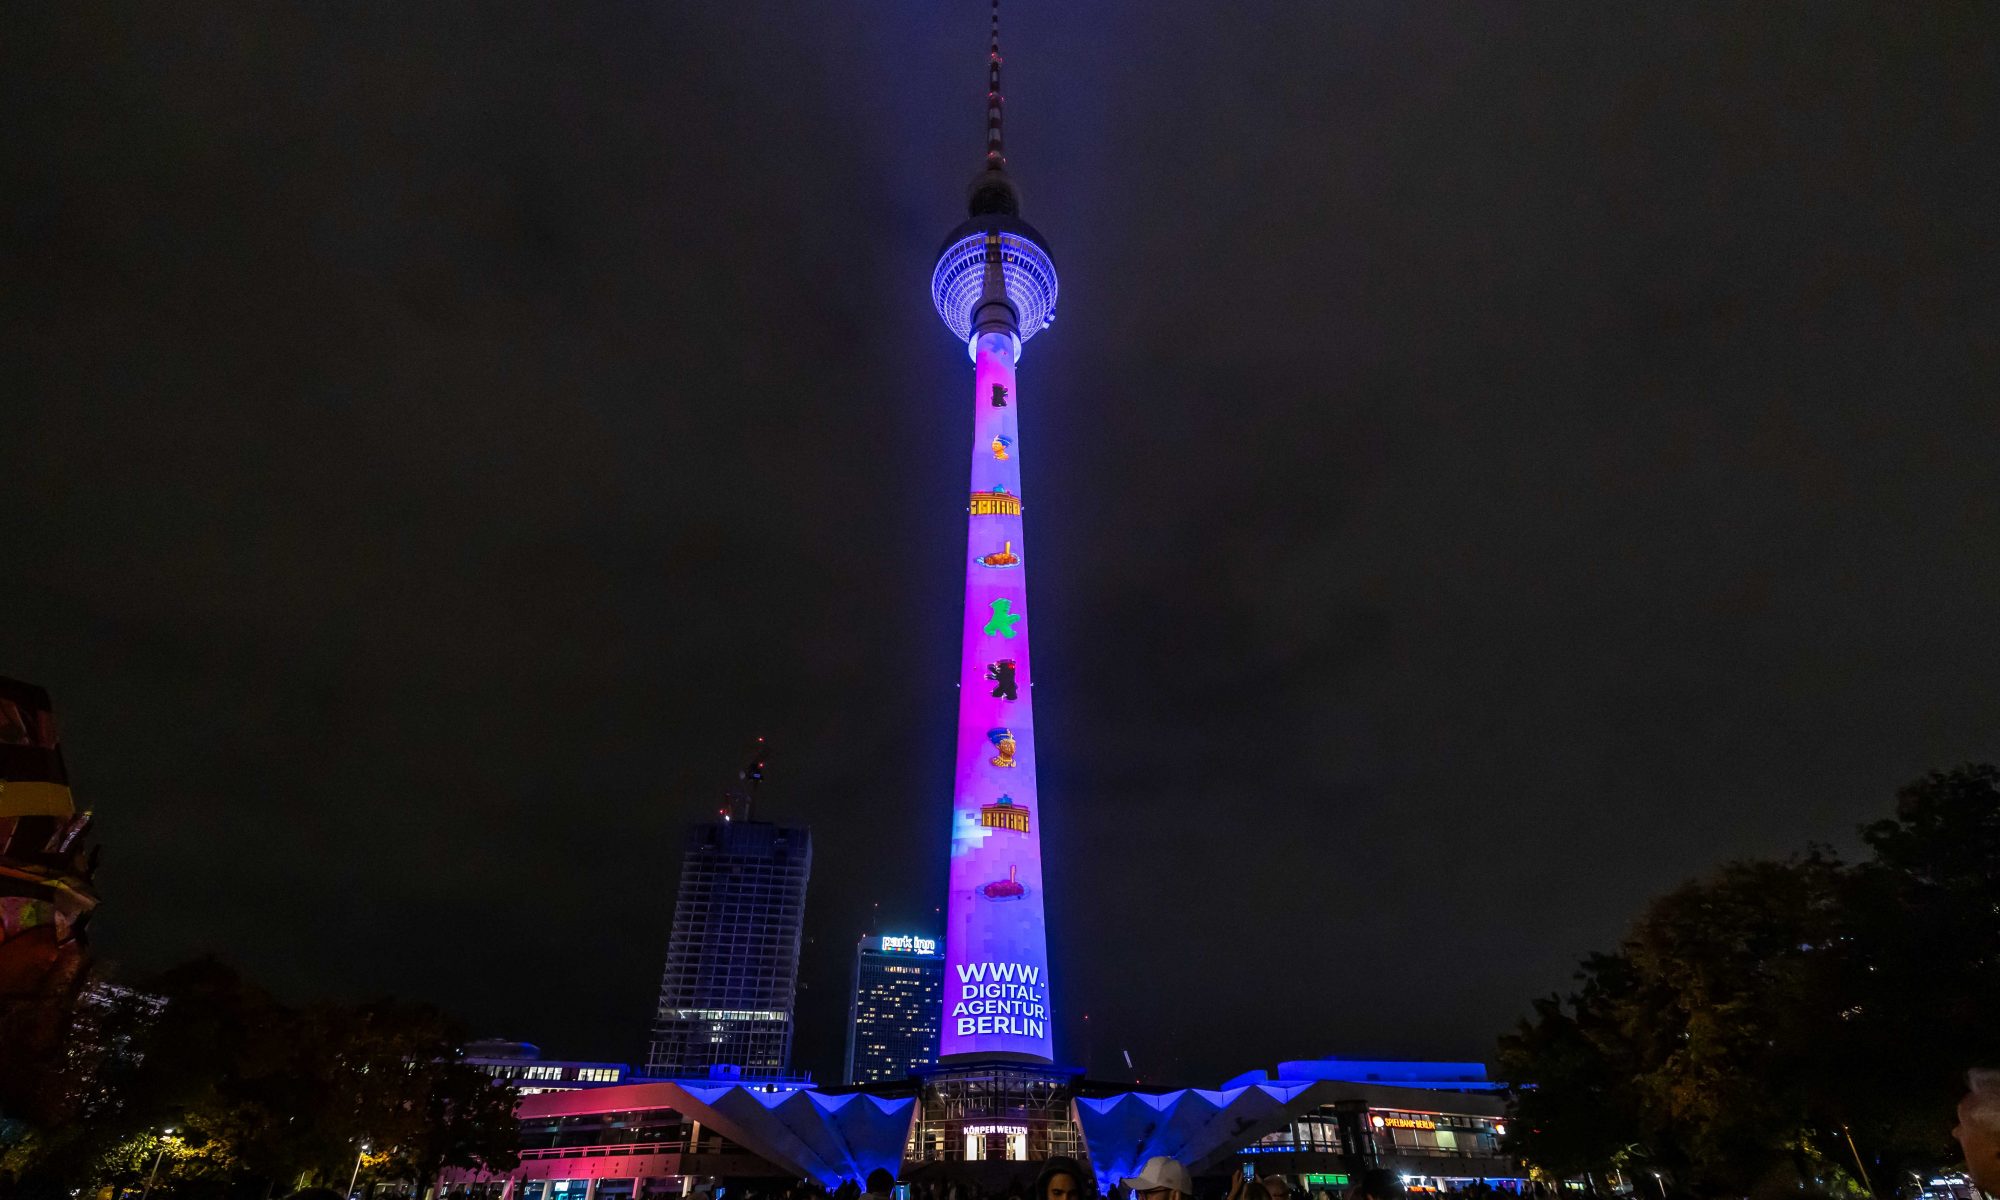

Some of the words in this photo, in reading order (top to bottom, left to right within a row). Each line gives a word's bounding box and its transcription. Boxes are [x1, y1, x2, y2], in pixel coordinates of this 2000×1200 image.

[882, 935, 912, 951] park
[914, 936, 935, 949] inn
[956, 963, 1045, 987] WWW.
[962, 983, 1041, 1002] DIGITAL-
[952, 1000, 1048, 1020] AGENTUR.
[957, 1016, 1043, 1039] BERLIN
[963, 1125, 995, 1134] KÖRPER
[997, 1125, 1028, 1134] WELTEN
[1416, 1119, 1435, 1129] BERLIN
